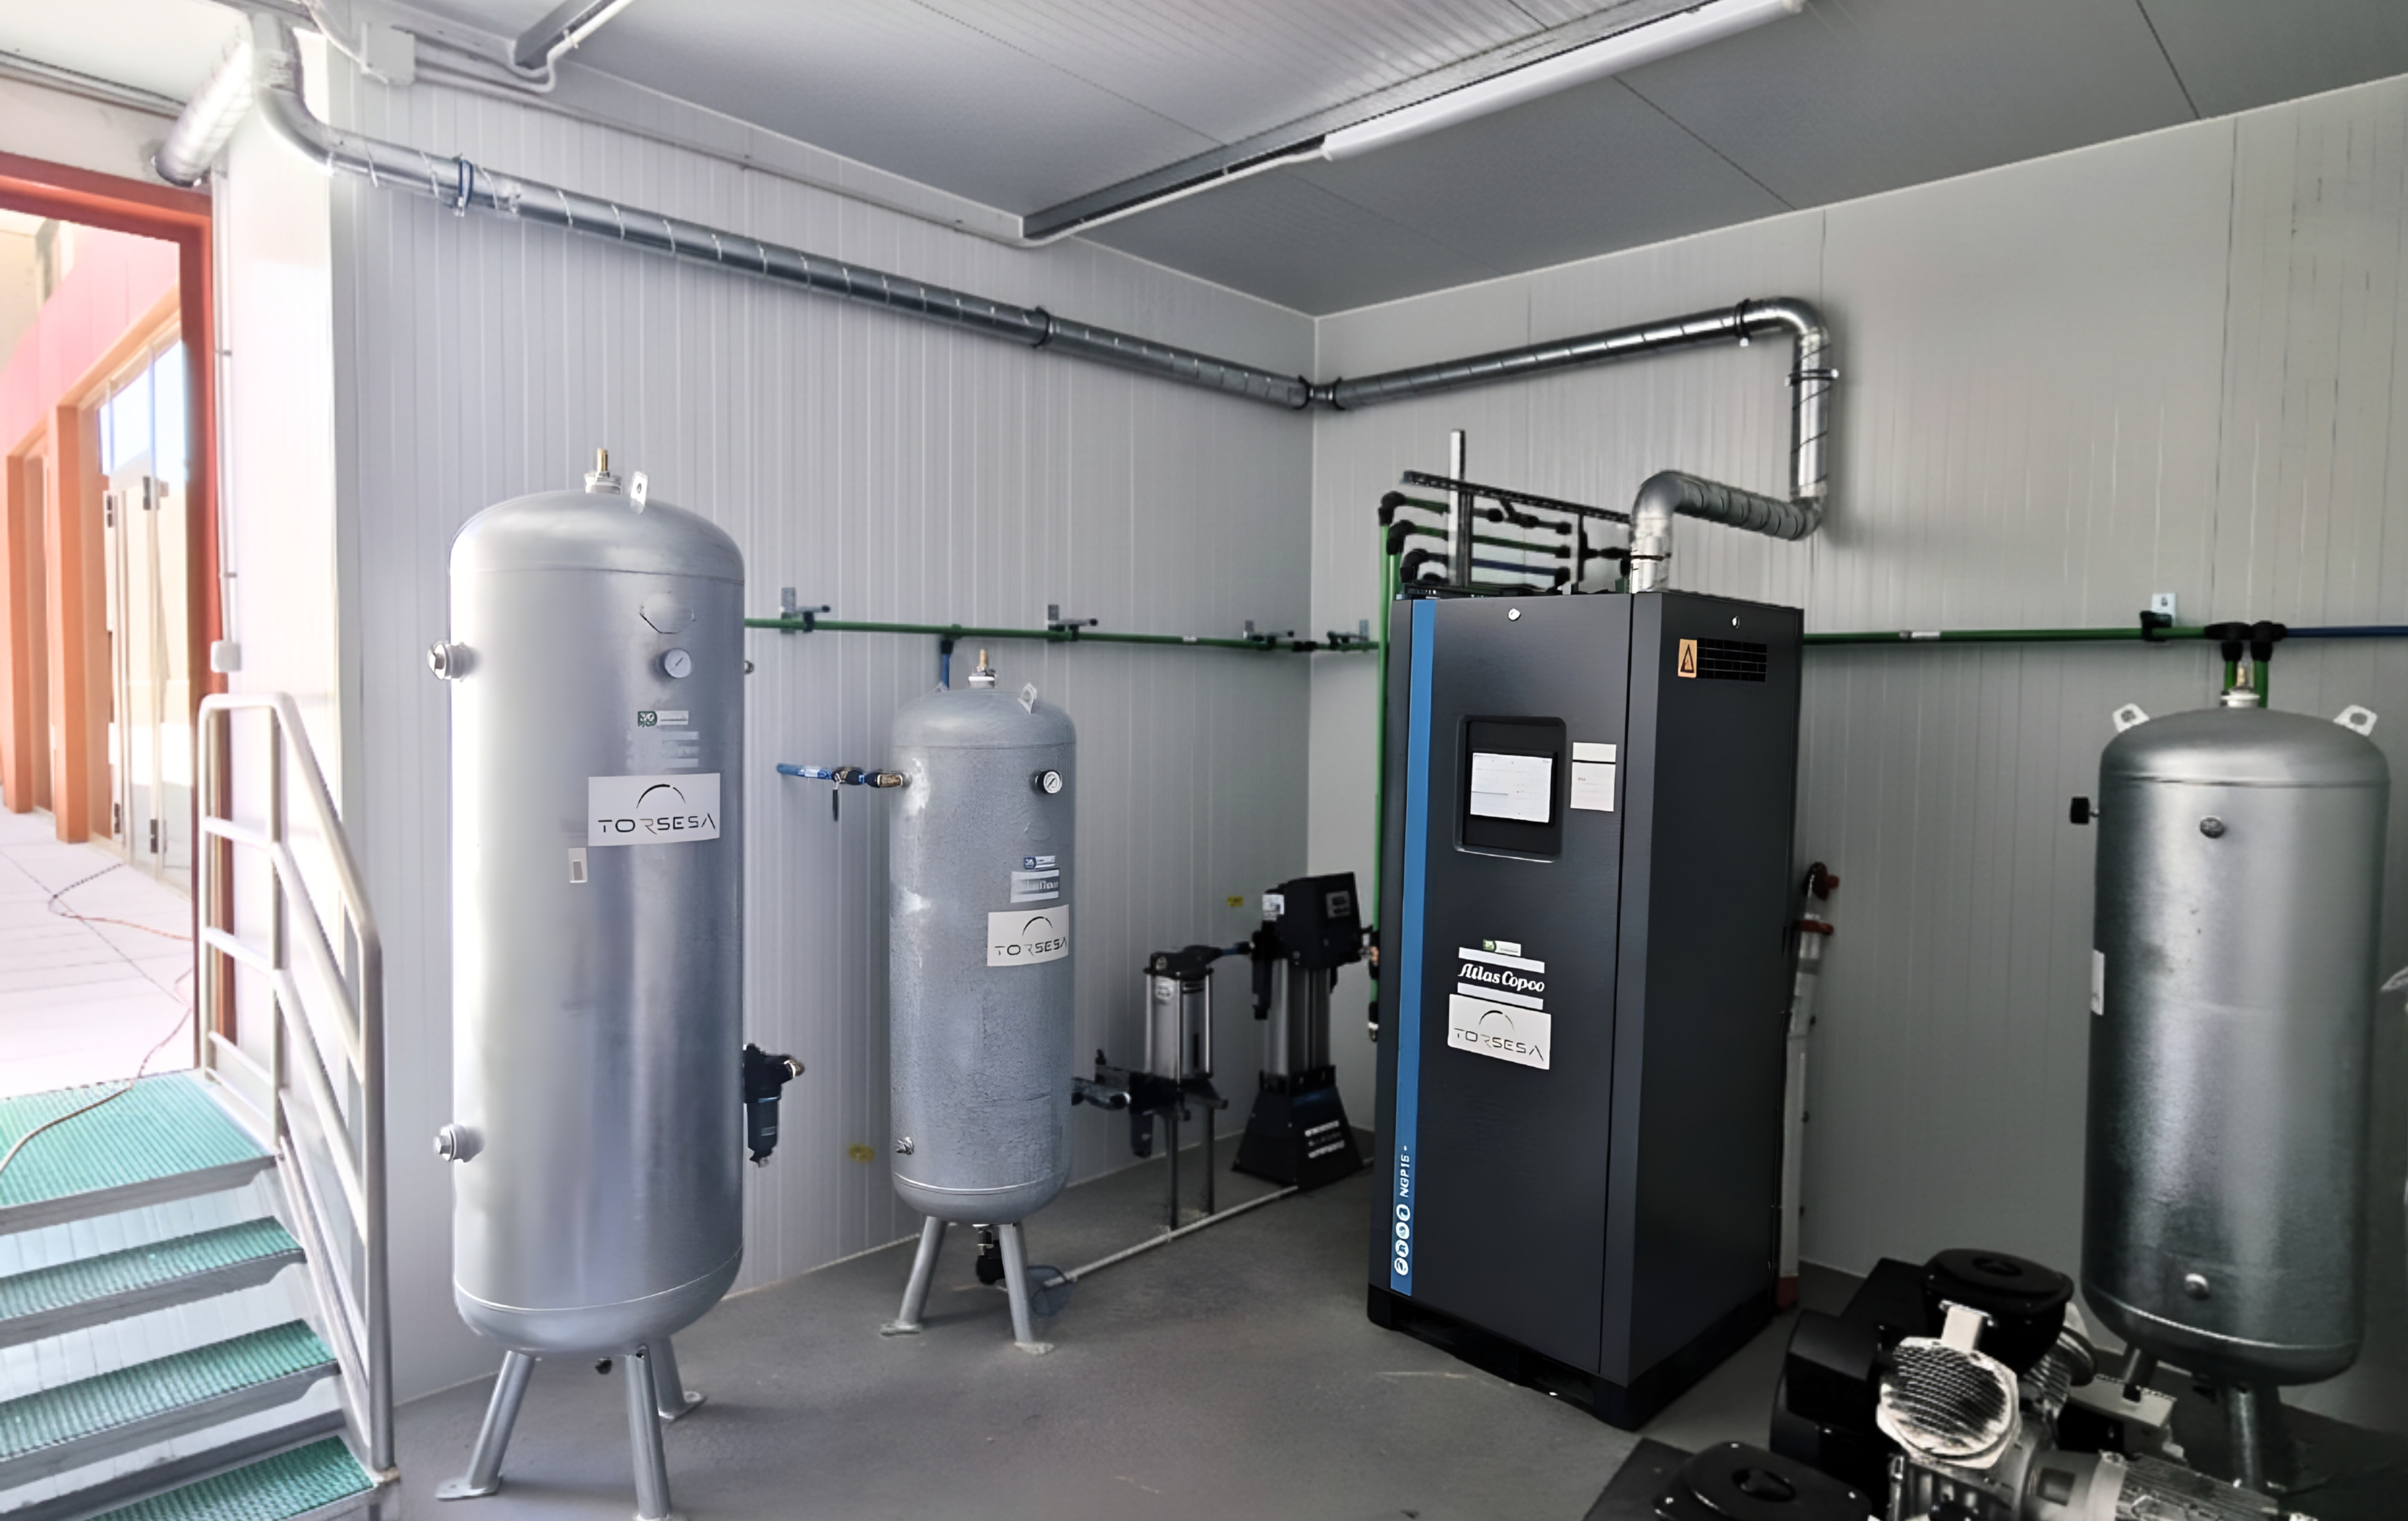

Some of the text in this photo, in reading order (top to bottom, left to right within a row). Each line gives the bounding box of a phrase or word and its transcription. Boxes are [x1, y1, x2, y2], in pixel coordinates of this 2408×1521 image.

[598, 813, 716, 834] TORSESA
[994, 937, 1067, 956] TORSESA
[1458, 963, 1545, 992] Atlas Copco
[1454, 1028, 1544, 1061] TORSESA
